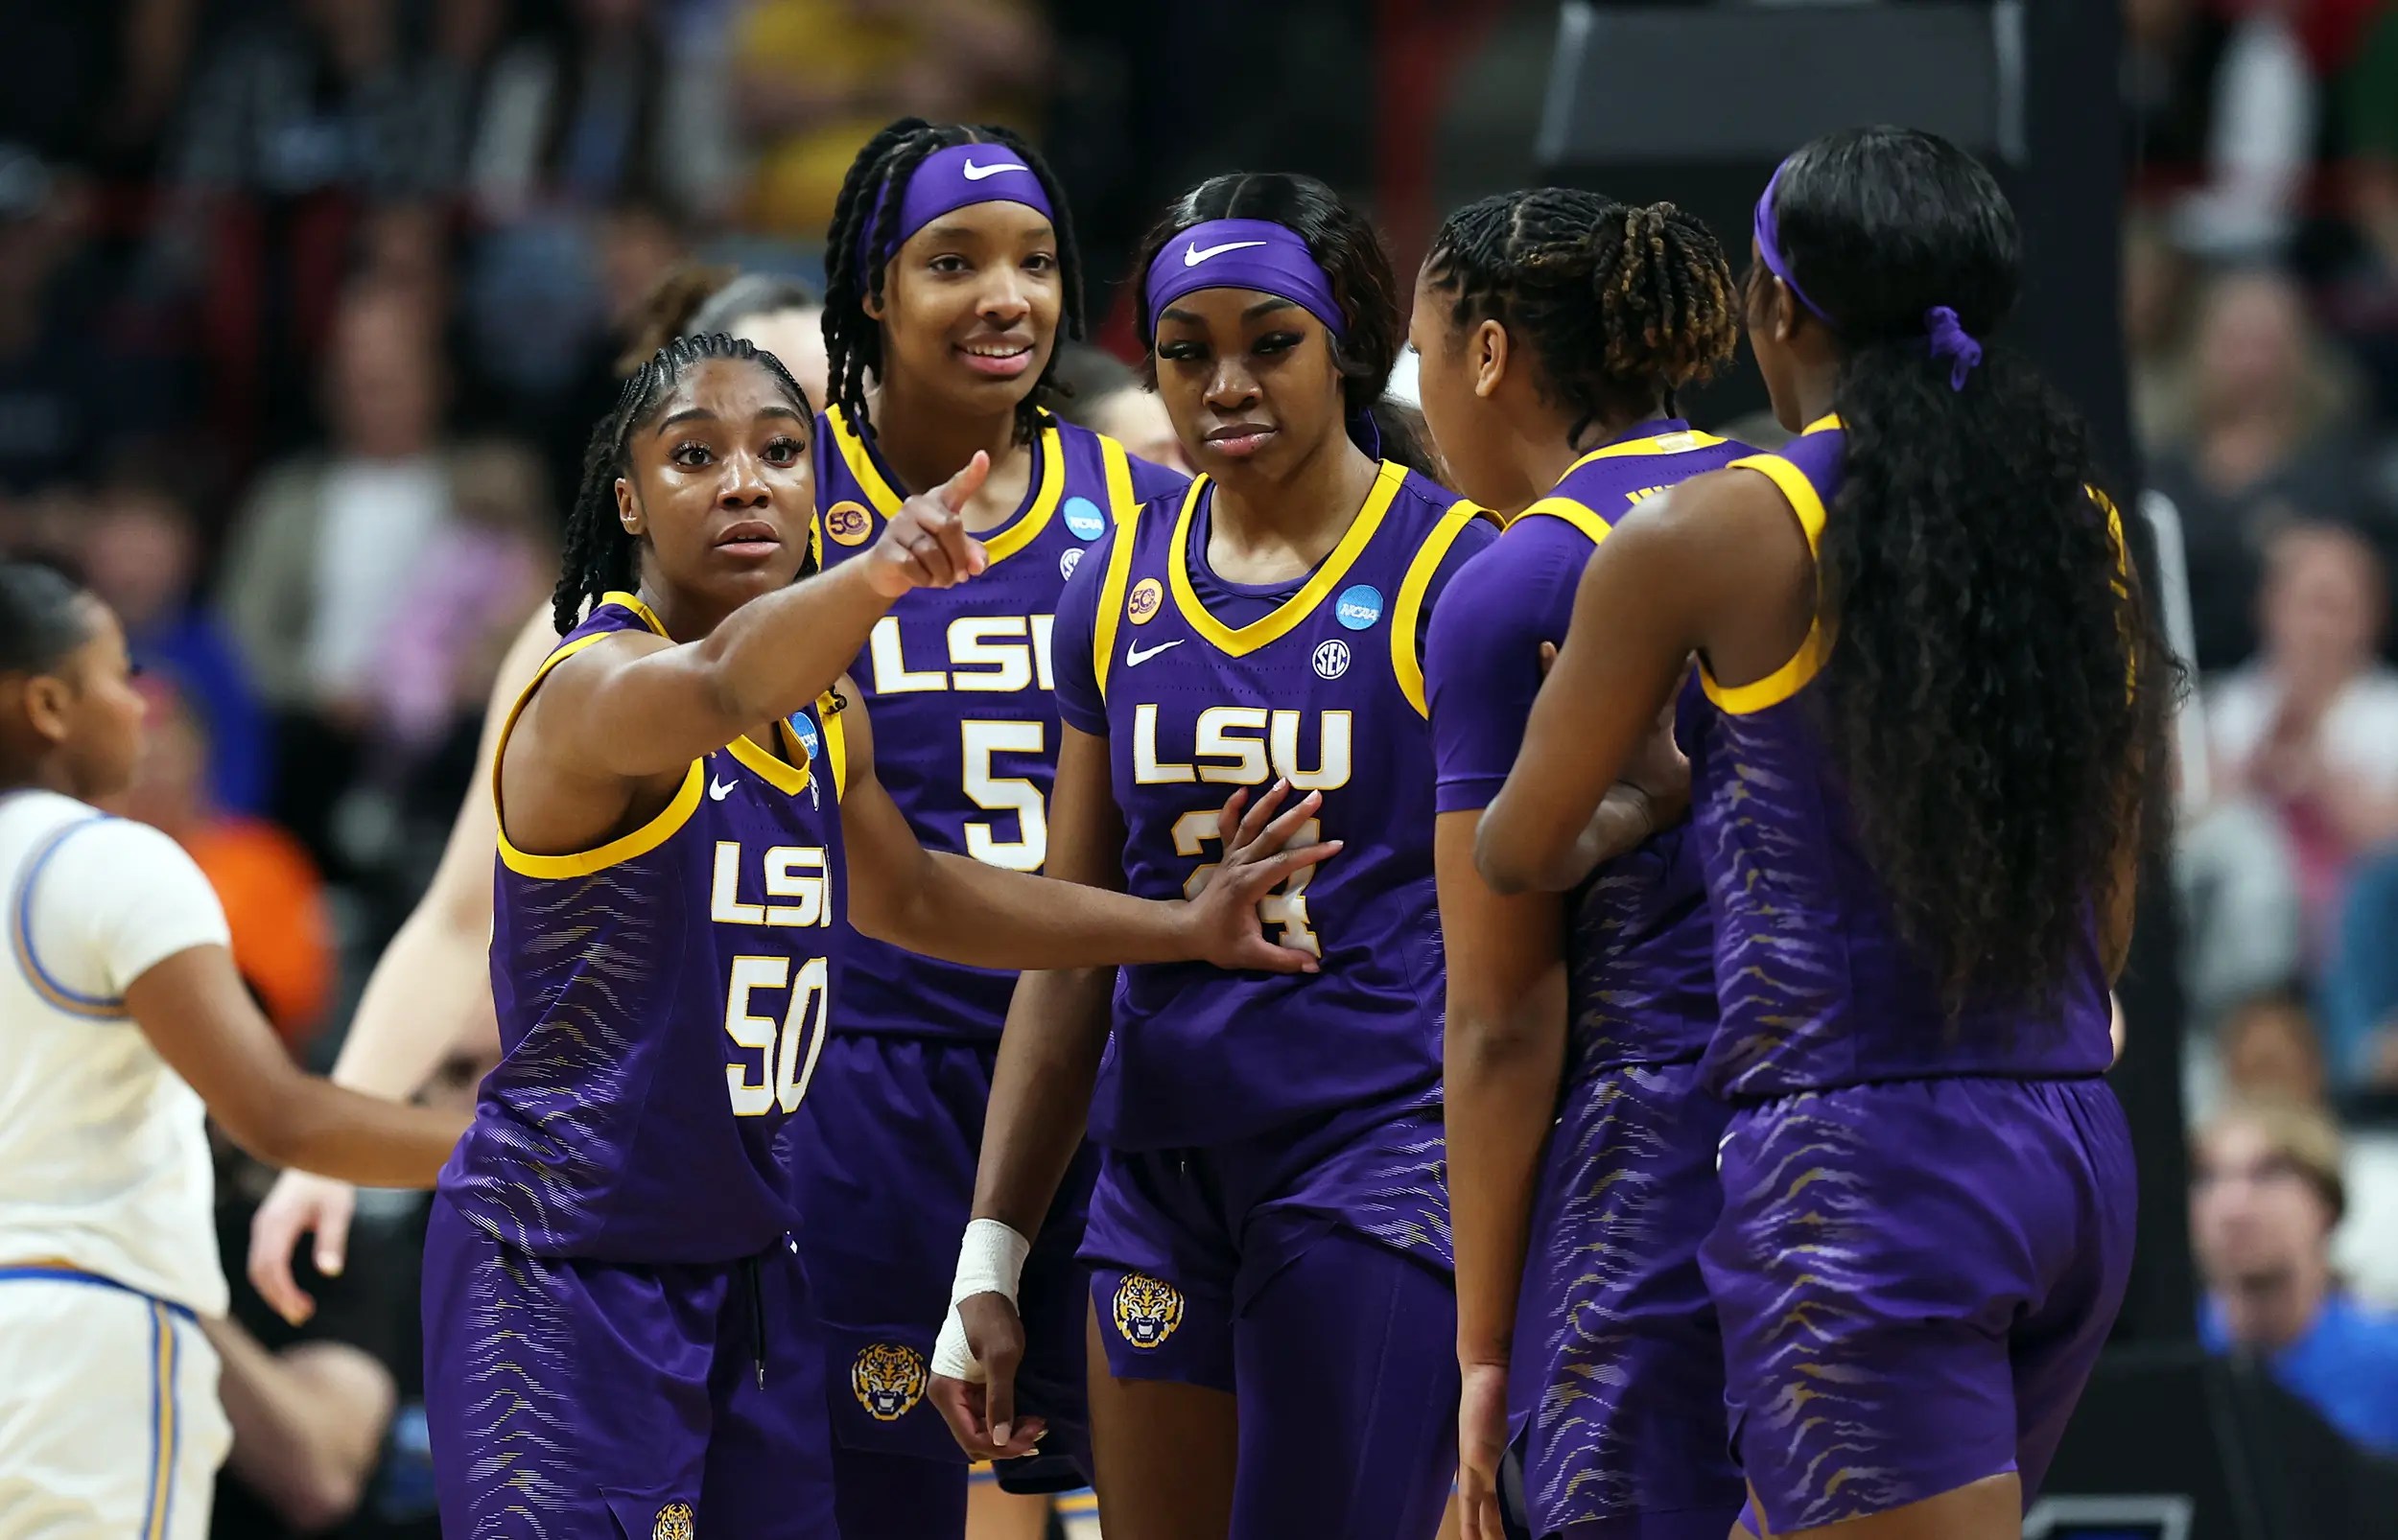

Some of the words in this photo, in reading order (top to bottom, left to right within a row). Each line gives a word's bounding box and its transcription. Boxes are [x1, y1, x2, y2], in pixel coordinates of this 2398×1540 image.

[1340, 602, 1380, 621] NCAA
[1316, 642, 1347, 676] SEC
[1134, 704, 1352, 790] LSU
[961, 719, 1047, 873] 5
[711, 841, 831, 927] LS
[725, 956, 828, 1116] 50
